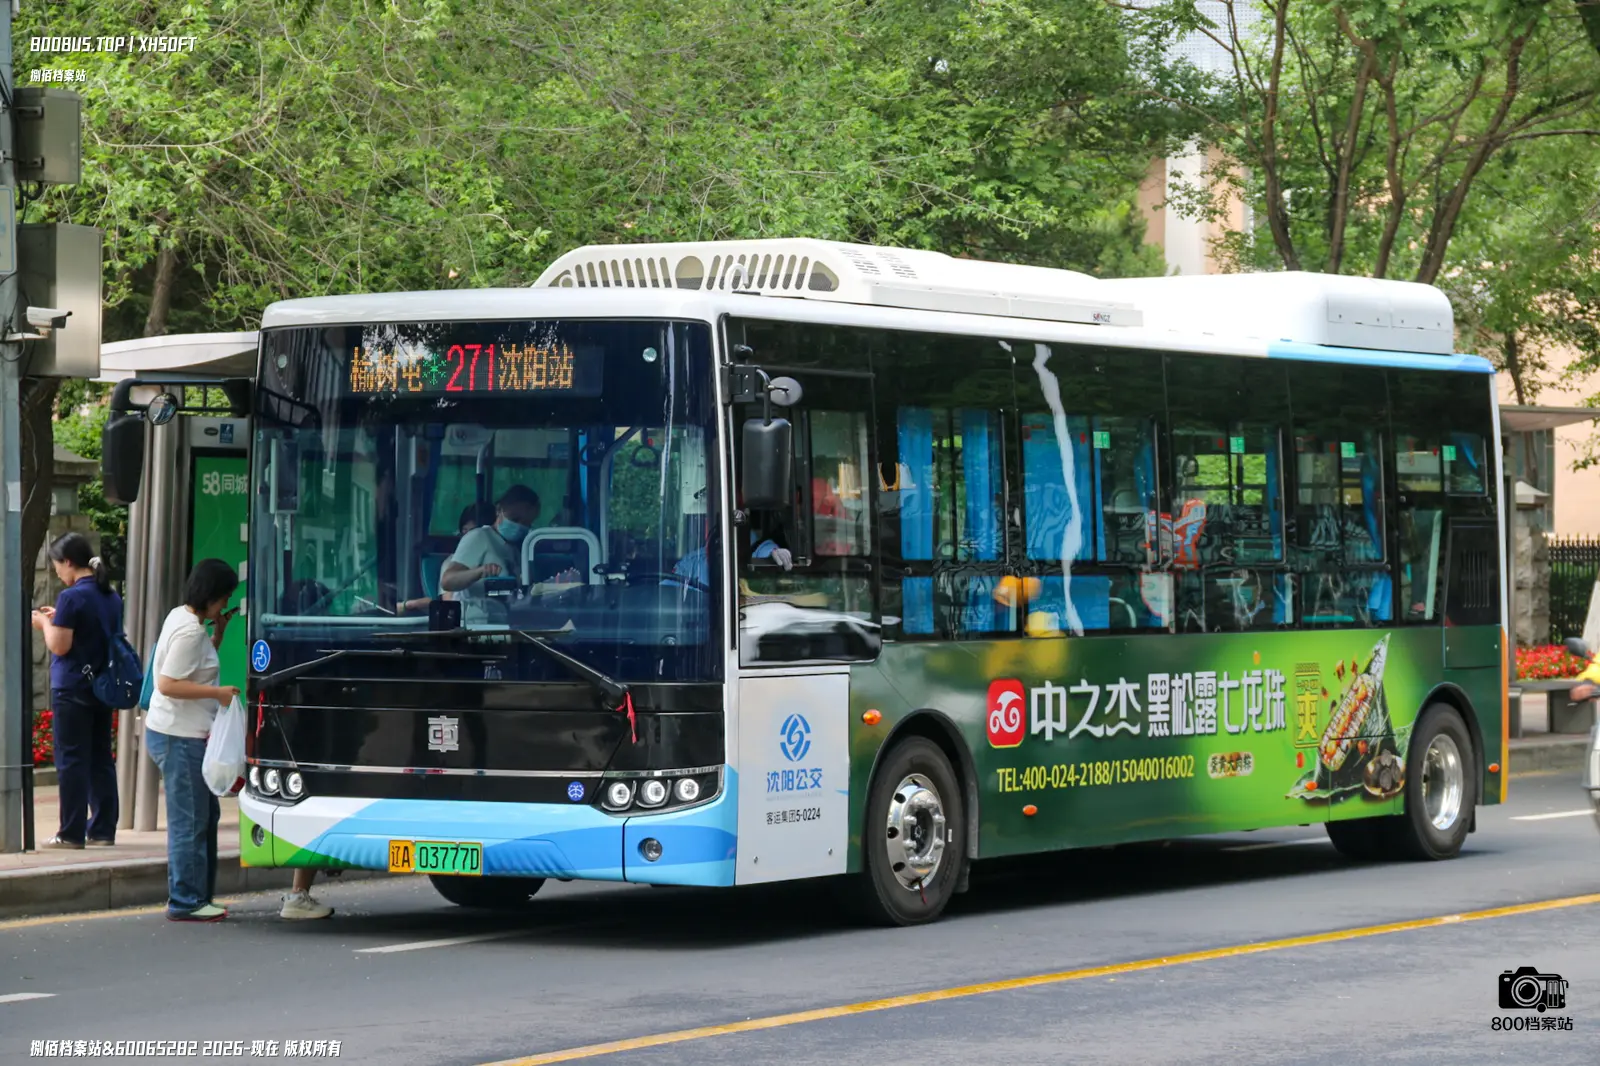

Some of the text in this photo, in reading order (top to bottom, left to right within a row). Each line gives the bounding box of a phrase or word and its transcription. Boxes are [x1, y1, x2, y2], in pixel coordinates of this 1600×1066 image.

[446, 344, 494, 391] 271
[499, 343, 574, 390] 沈阳站
[202, 471, 248, 496] 58同城
[1030, 677, 1142, 741] 中之杰
[1147, 668, 1286, 737] 黑松露七龙珠
[767, 768, 822, 792] 沈阳公交
[997, 755, 1195, 793] TEL:400-024-2188/15040016002
[766, 807, 821, 825] 客运集团5-0224
[391, 845, 479, 870] 辽A 03777D
